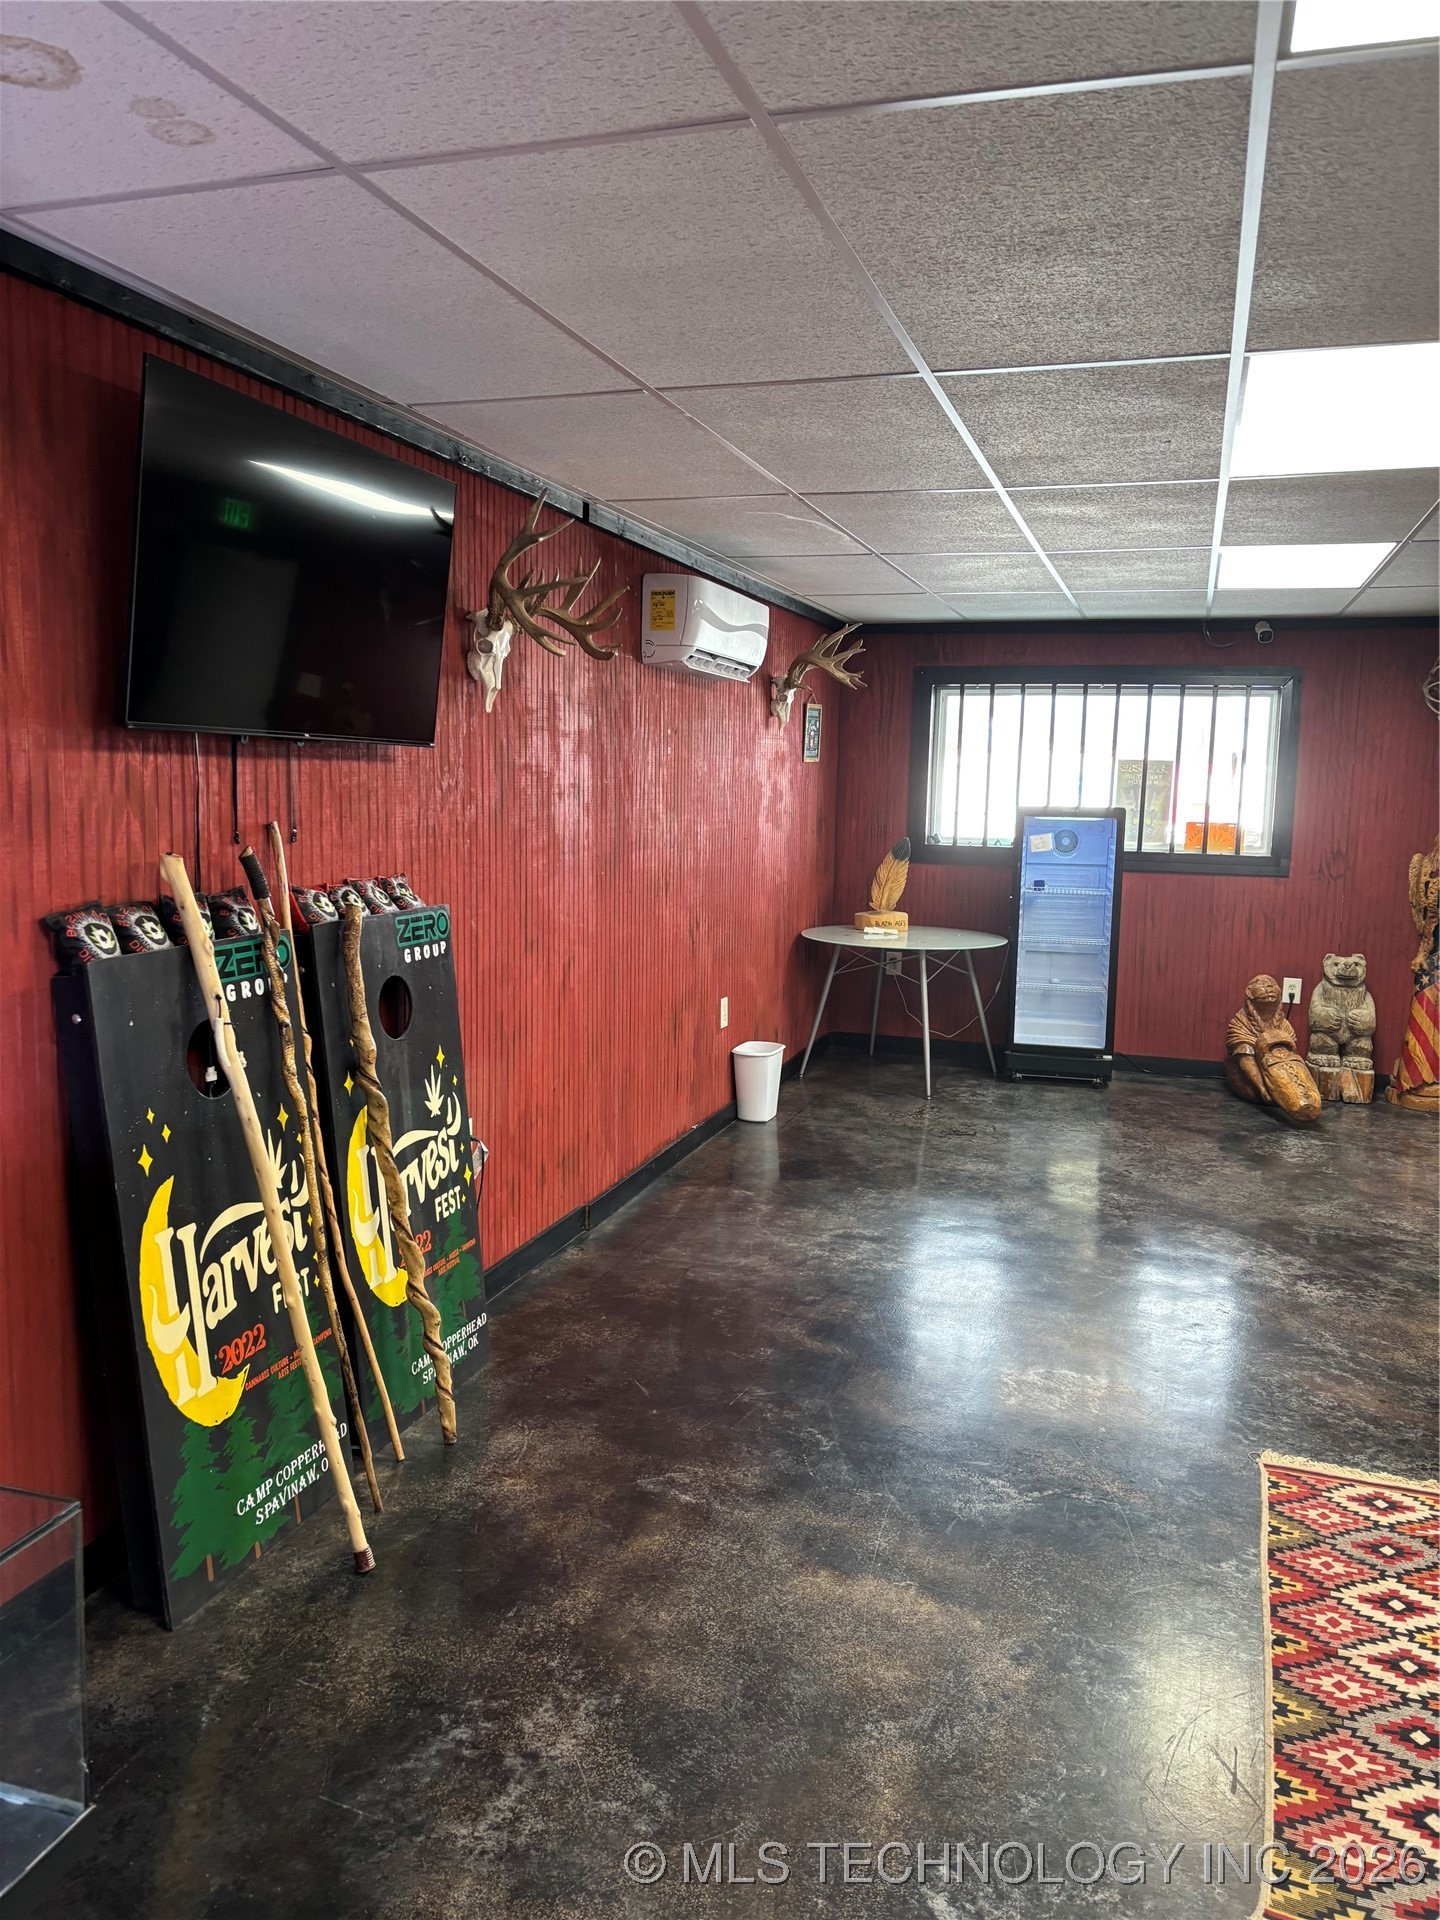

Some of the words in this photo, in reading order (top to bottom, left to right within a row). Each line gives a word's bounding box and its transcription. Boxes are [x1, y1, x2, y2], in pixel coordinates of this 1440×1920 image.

[395, 910, 450, 947] ZERO
[404, 940, 447, 963] GROUP
[226, 972, 288, 1001] GRO
[434, 1185, 461, 1222] FEST
[218, 1323, 267, 1375] 2022
[441, 1312, 487, 1353] OPPERHEAD
[468, 1333, 479, 1350] OK
[245, 1369, 270, 1391] CANNABIS
[270, 1356, 289, 1374] CULTURE
[236, 1478, 273, 1516] CAMP
[255, 1463, 320, 1525] SPAVINAW,
[320, 1457, 329, 1472] O
